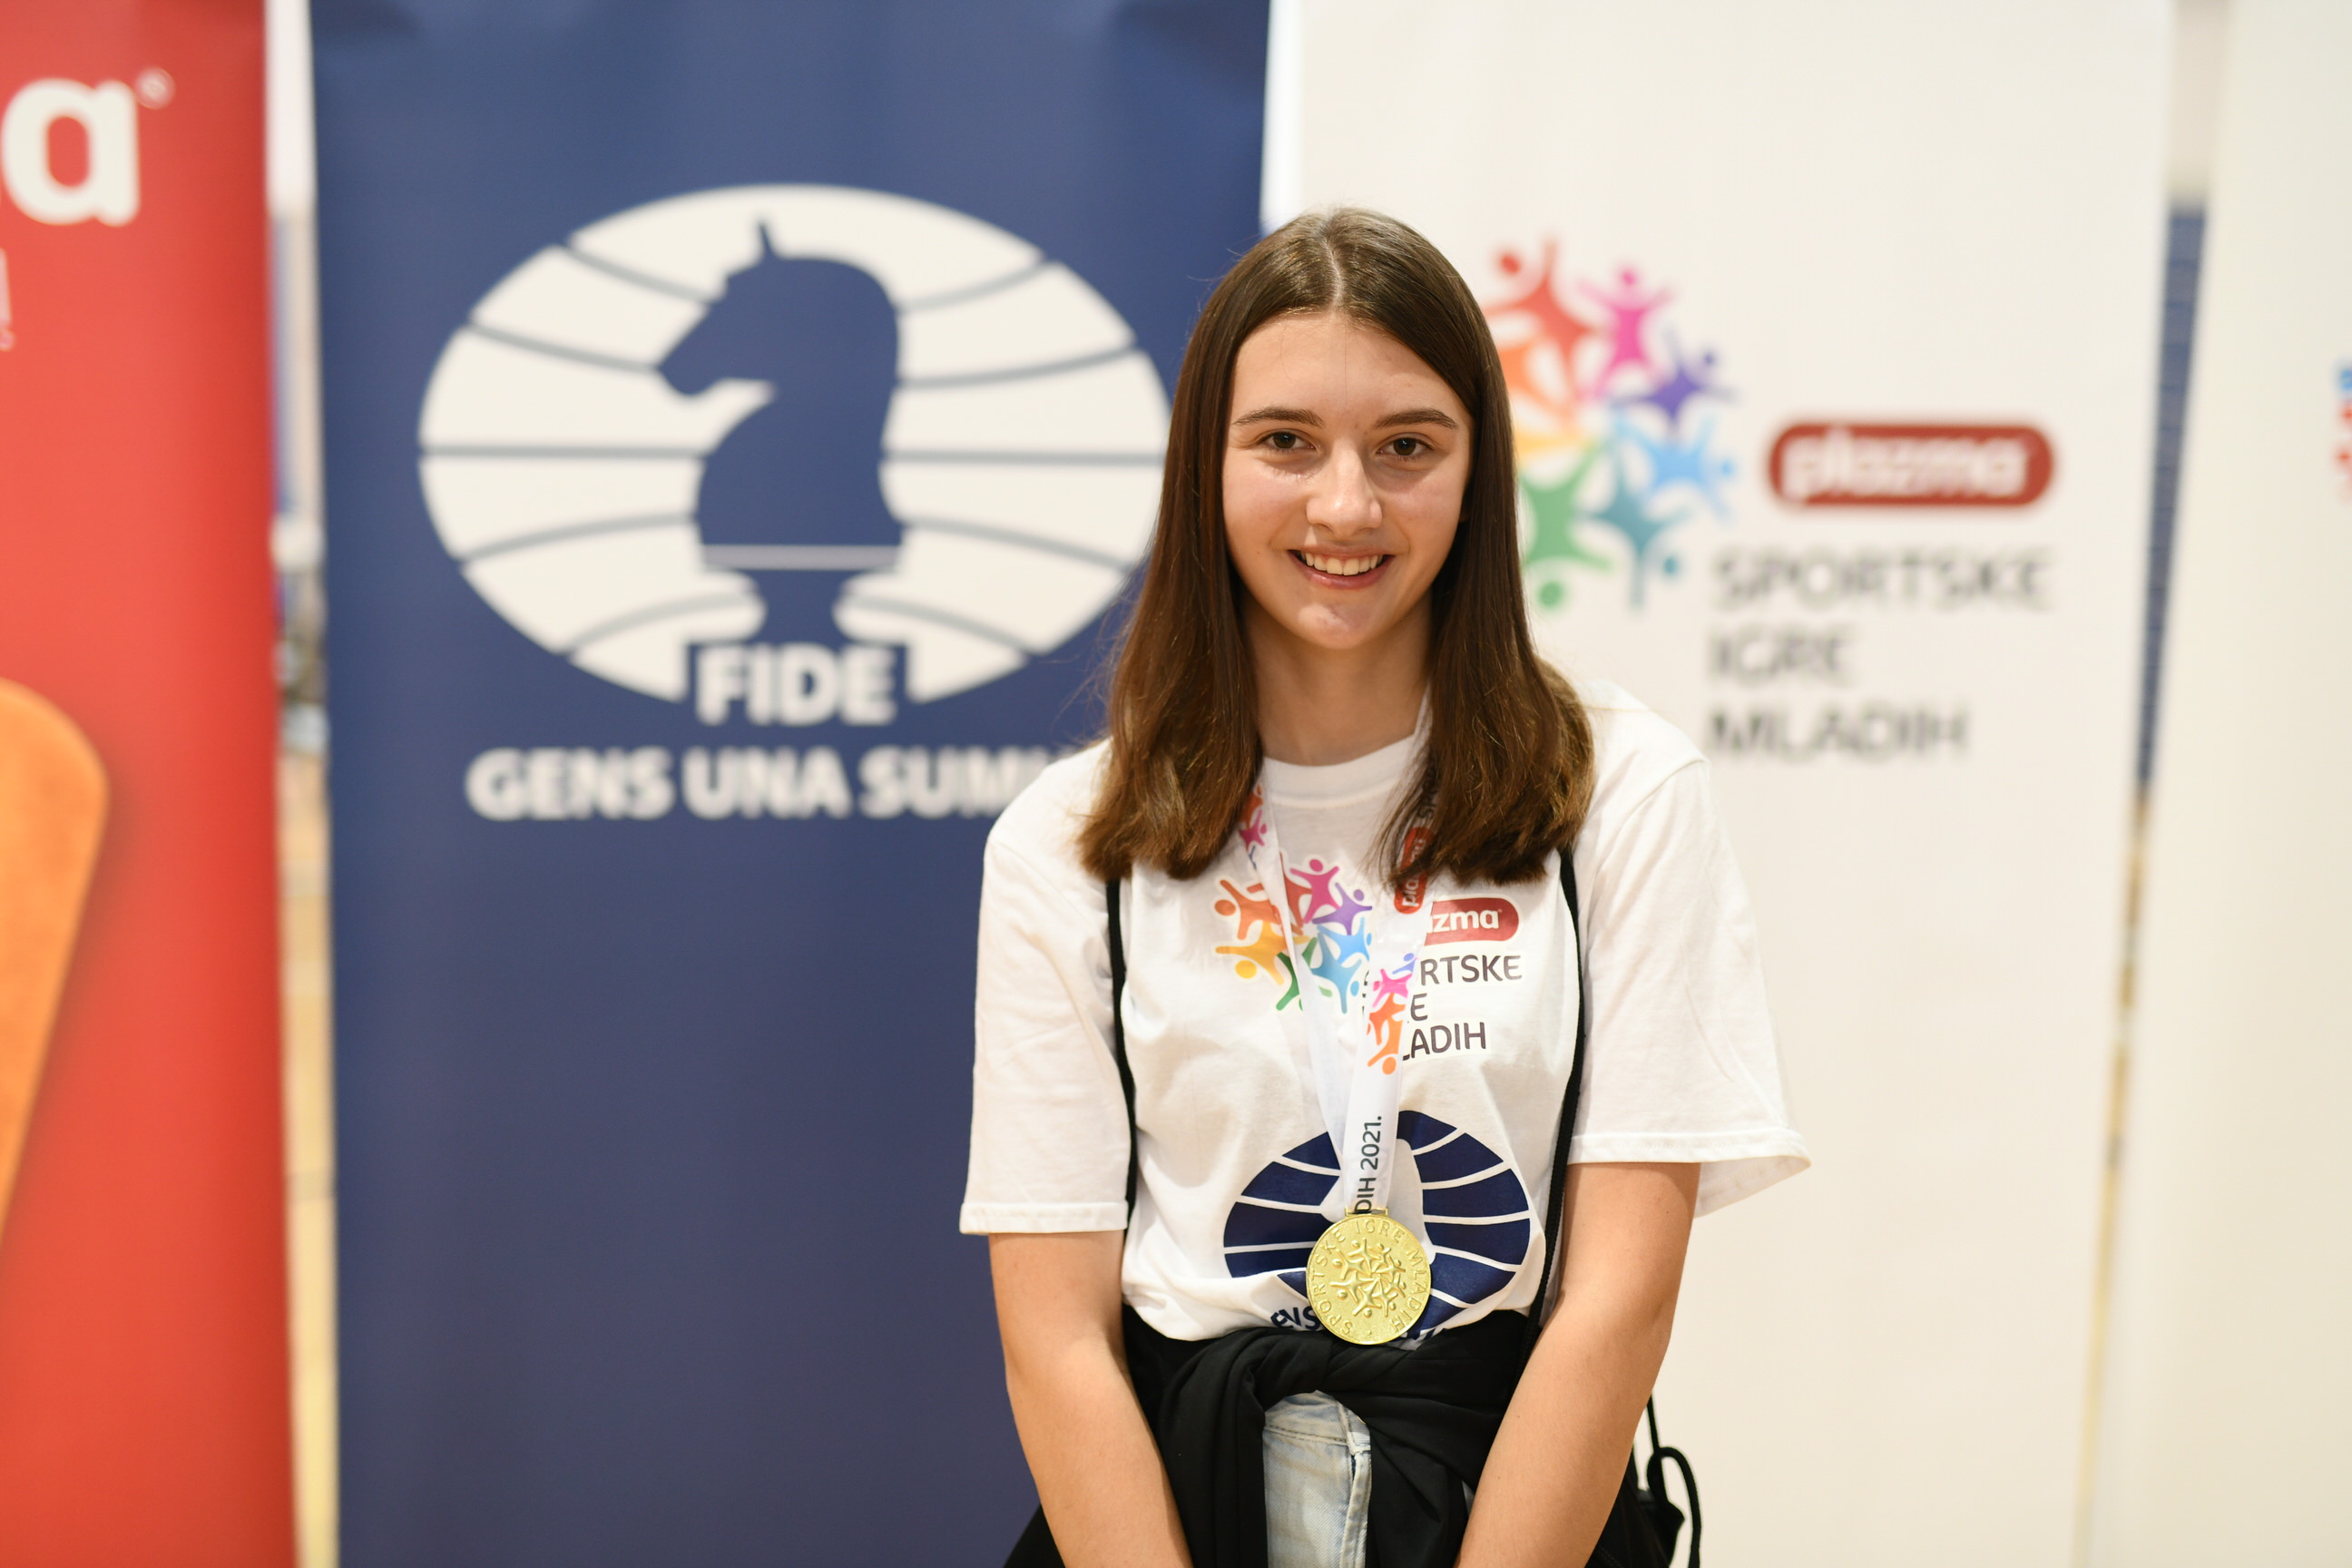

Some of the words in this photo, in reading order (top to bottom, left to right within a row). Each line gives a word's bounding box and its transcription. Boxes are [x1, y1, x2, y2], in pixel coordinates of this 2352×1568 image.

[1781, 427, 2025, 506] plazma
[1710, 546, 2053, 612] SPORTSKE
[697, 643, 897, 726] FIDE
[1708, 624, 1857, 689] IGRE
[1708, 703, 1971, 763] MLADIH
[465, 747, 675, 819] GENS
[681, 747, 853, 819] UNA
[858, 746, 1075, 819] SUM
[1426, 909, 1500, 934] zma
[1420, 955, 1523, 986] RTSKE
[1403, 1022, 1486, 1061] ADIH
[1360, 1116, 1382, 1170] 2021.
[1354, 1178, 1377, 1214] DIH
[1311, 1228, 1353, 1335] SPORTSKE
[1356, 1219, 1405, 1244] IGRE
[1389, 1249, 1428, 1333] MLADIH
